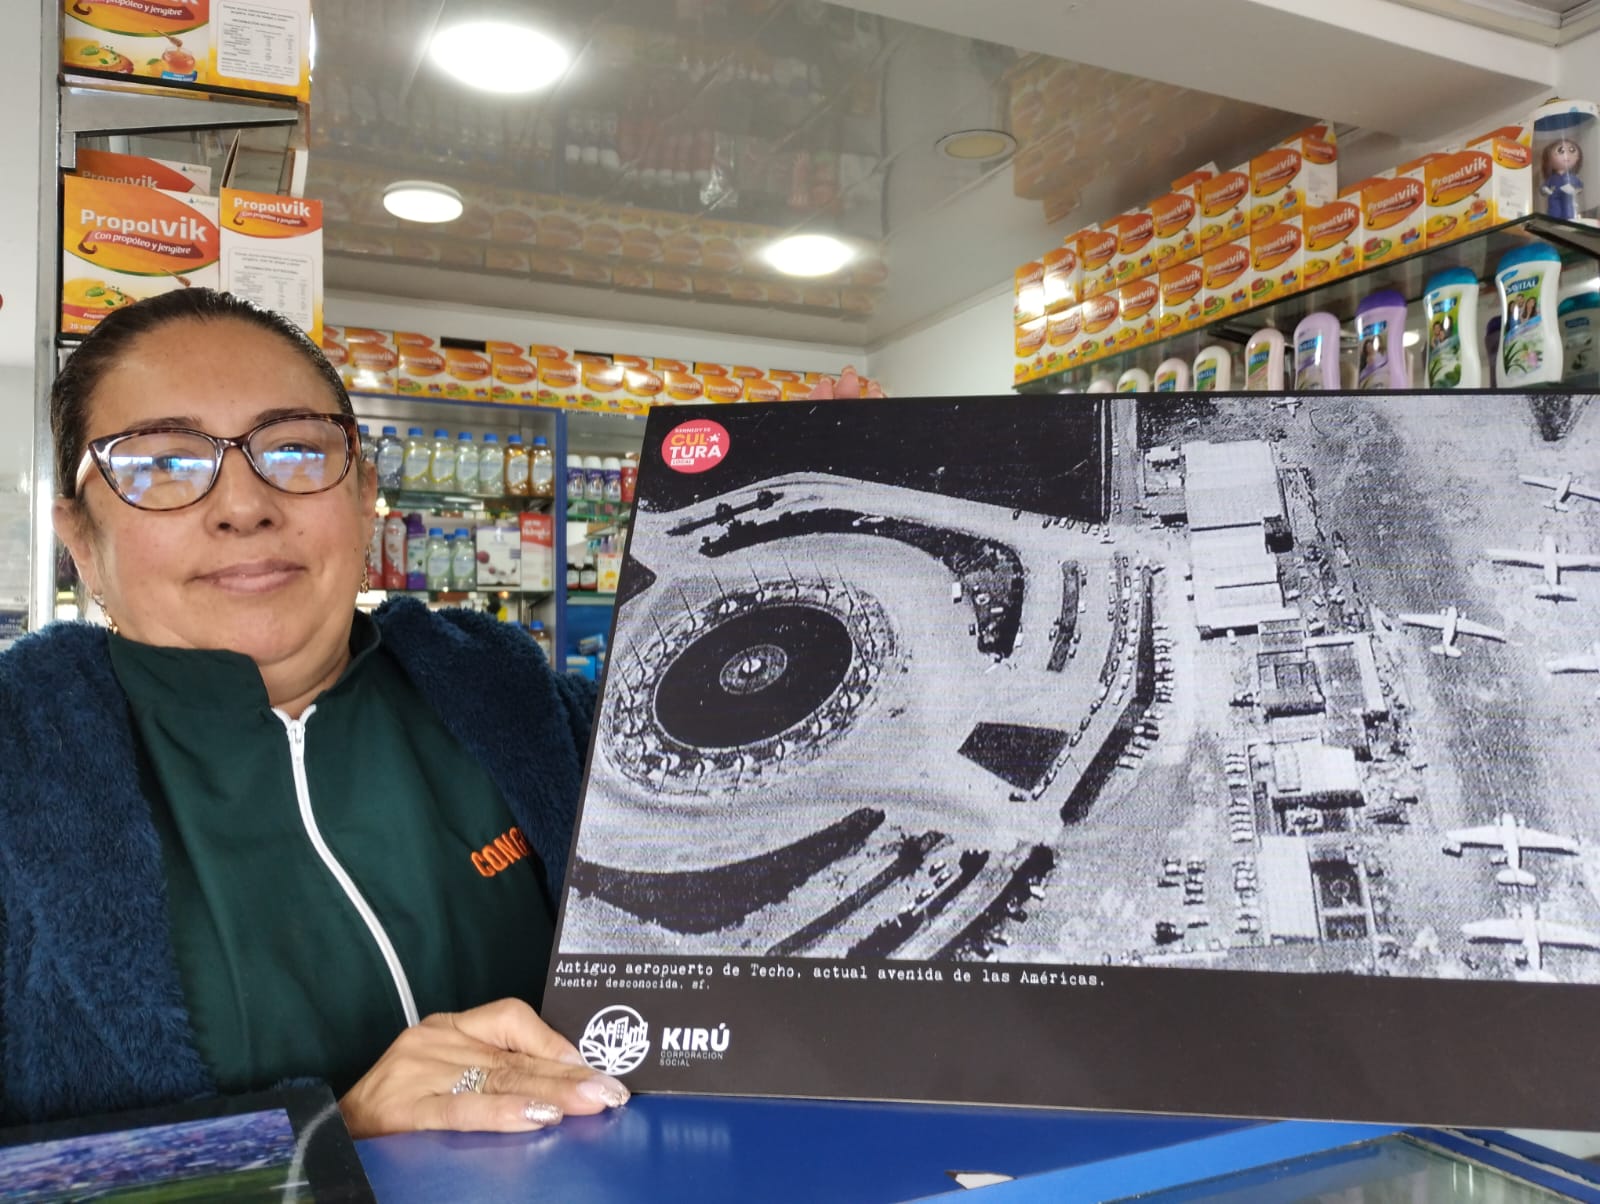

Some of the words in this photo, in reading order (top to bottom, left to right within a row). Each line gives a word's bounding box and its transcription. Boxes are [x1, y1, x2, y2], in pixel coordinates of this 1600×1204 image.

[150, 5, 183, 16] jengibre
[94, 230, 112, 240] Con
[112, 233, 151, 248] propóleo
[151, 241, 157, 251] y
[157, 242, 191, 255] jengibre
[671, 433, 708, 446] CUL
[669, 444, 721, 459] TURA
[555, 960, 616, 976] Antiguo
[626, 963, 713, 977] aeropuerto
[722, 963, 740, 976] de
[813, 965, 867, 979] actual
[878, 966, 943, 981] avenida
[954, 969, 971, 982] de
[982, 969, 1010, 983] las
[1020, 970, 1104, 986] Américas.
[662, 1023, 730, 1052] KIRÚ
[659, 1059, 690, 1068] SOCIAL
